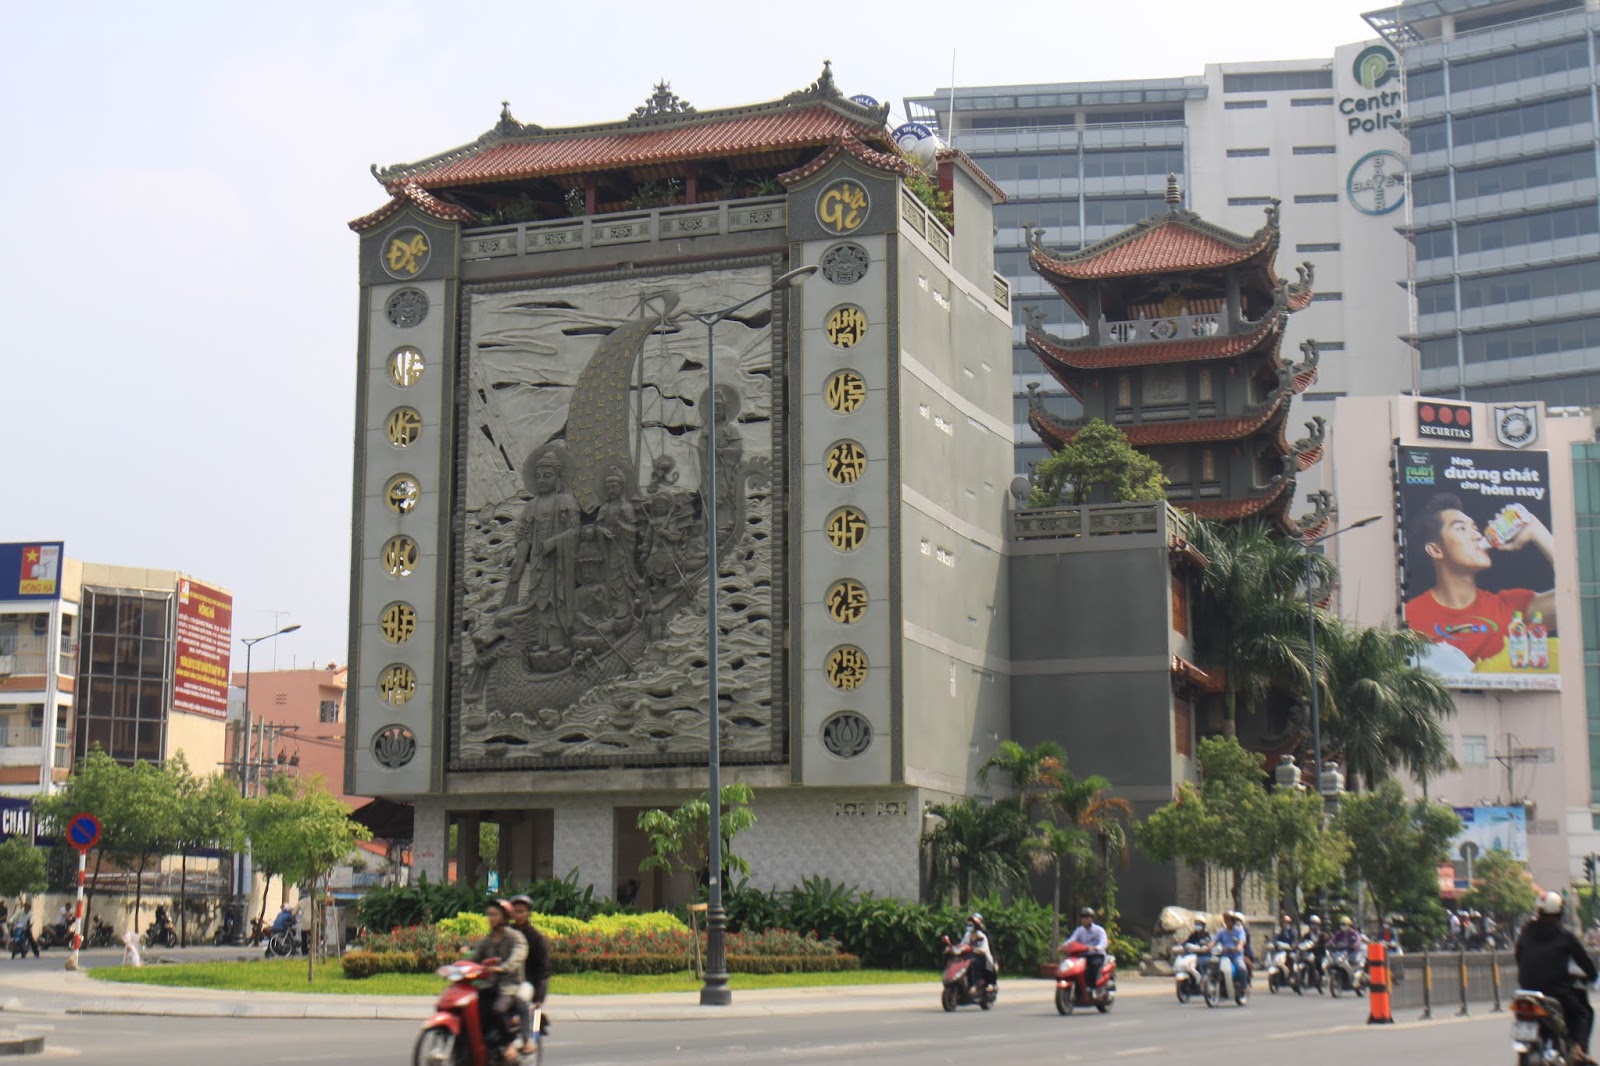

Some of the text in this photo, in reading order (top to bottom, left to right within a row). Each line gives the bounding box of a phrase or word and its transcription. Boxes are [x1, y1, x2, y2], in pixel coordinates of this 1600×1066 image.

[1339, 91, 1400, 115] Centr
[1420, 425, 1471, 438] SECURITAS
[1460, 480, 1480, 490] cho
[1515, 486, 1545, 500] nay
